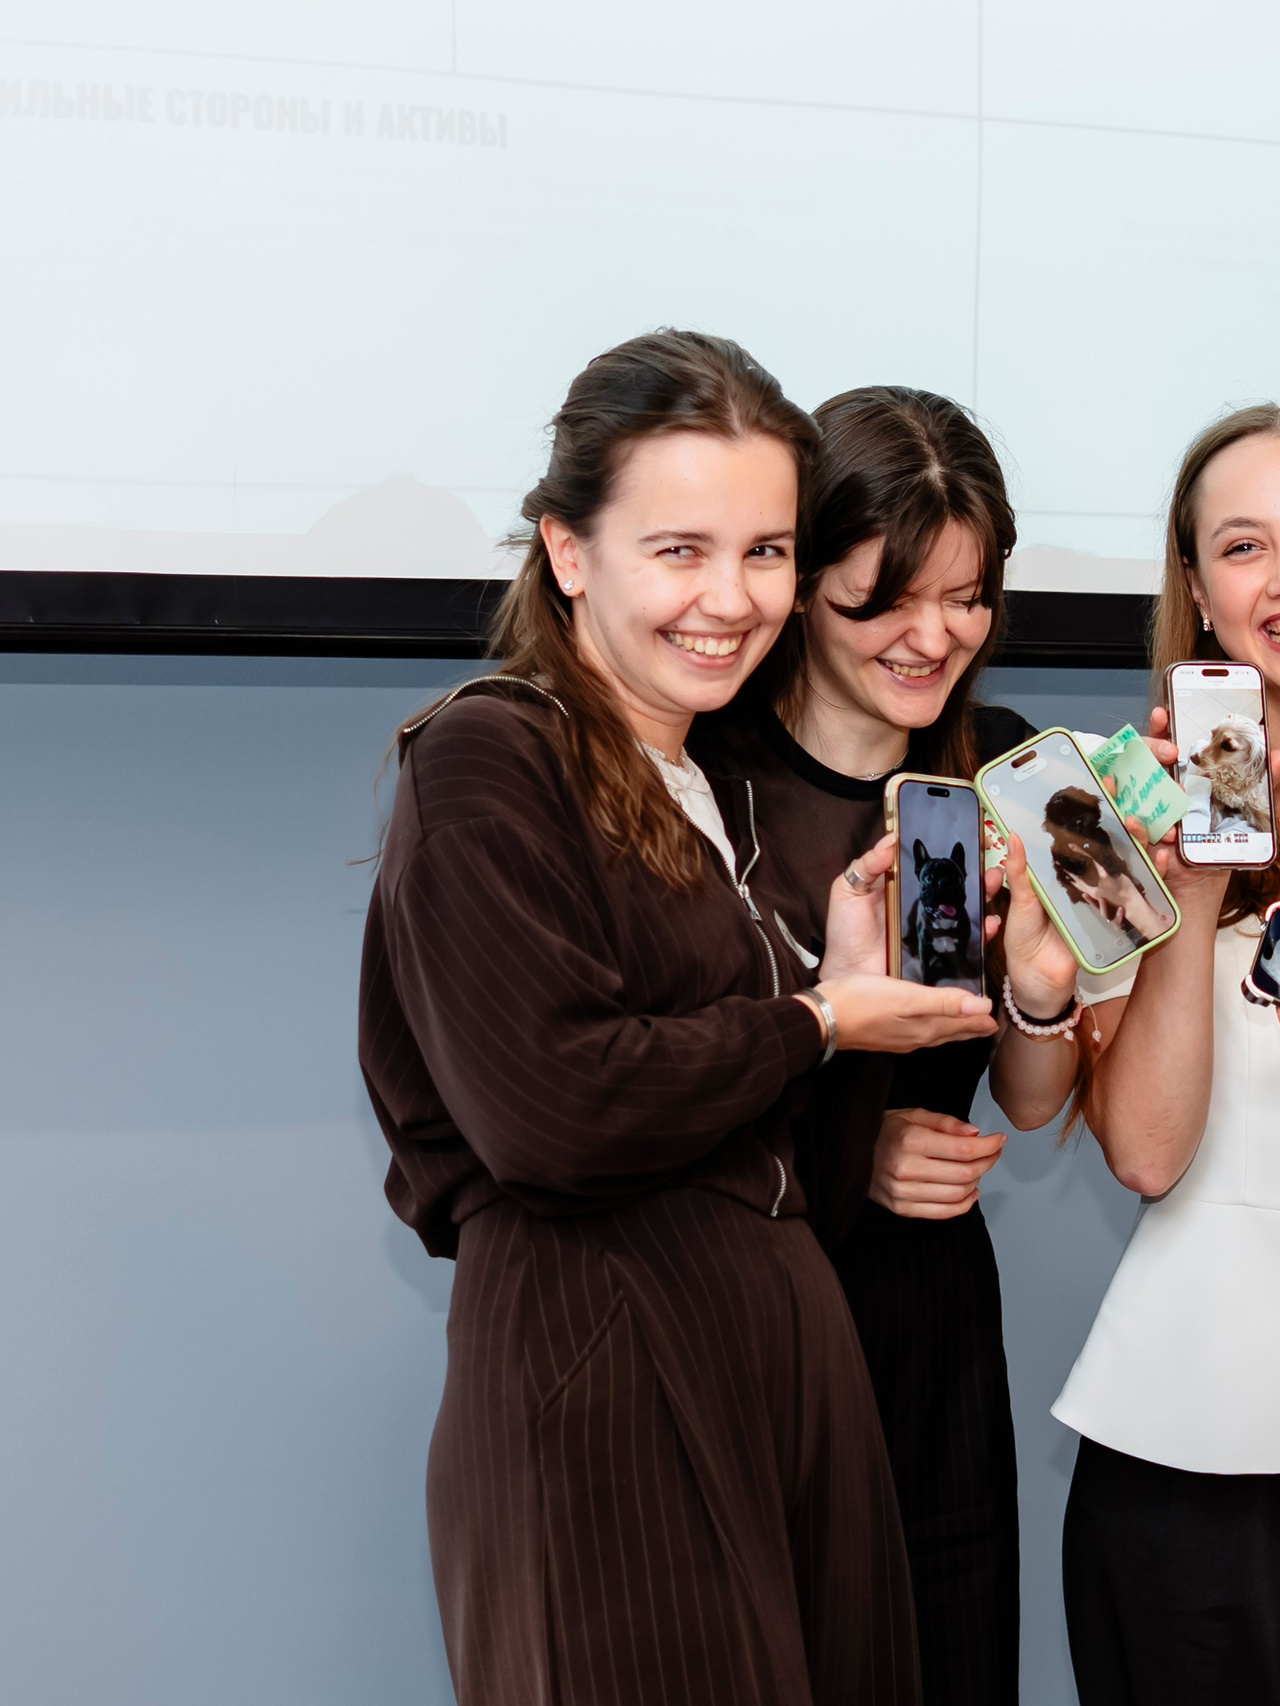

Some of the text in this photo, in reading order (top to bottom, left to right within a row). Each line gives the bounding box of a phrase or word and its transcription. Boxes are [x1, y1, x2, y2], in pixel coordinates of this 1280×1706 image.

[0, 77, 508, 149] ИЛЬНЫЕ СТОРОНЫ И АКТИВЫ
